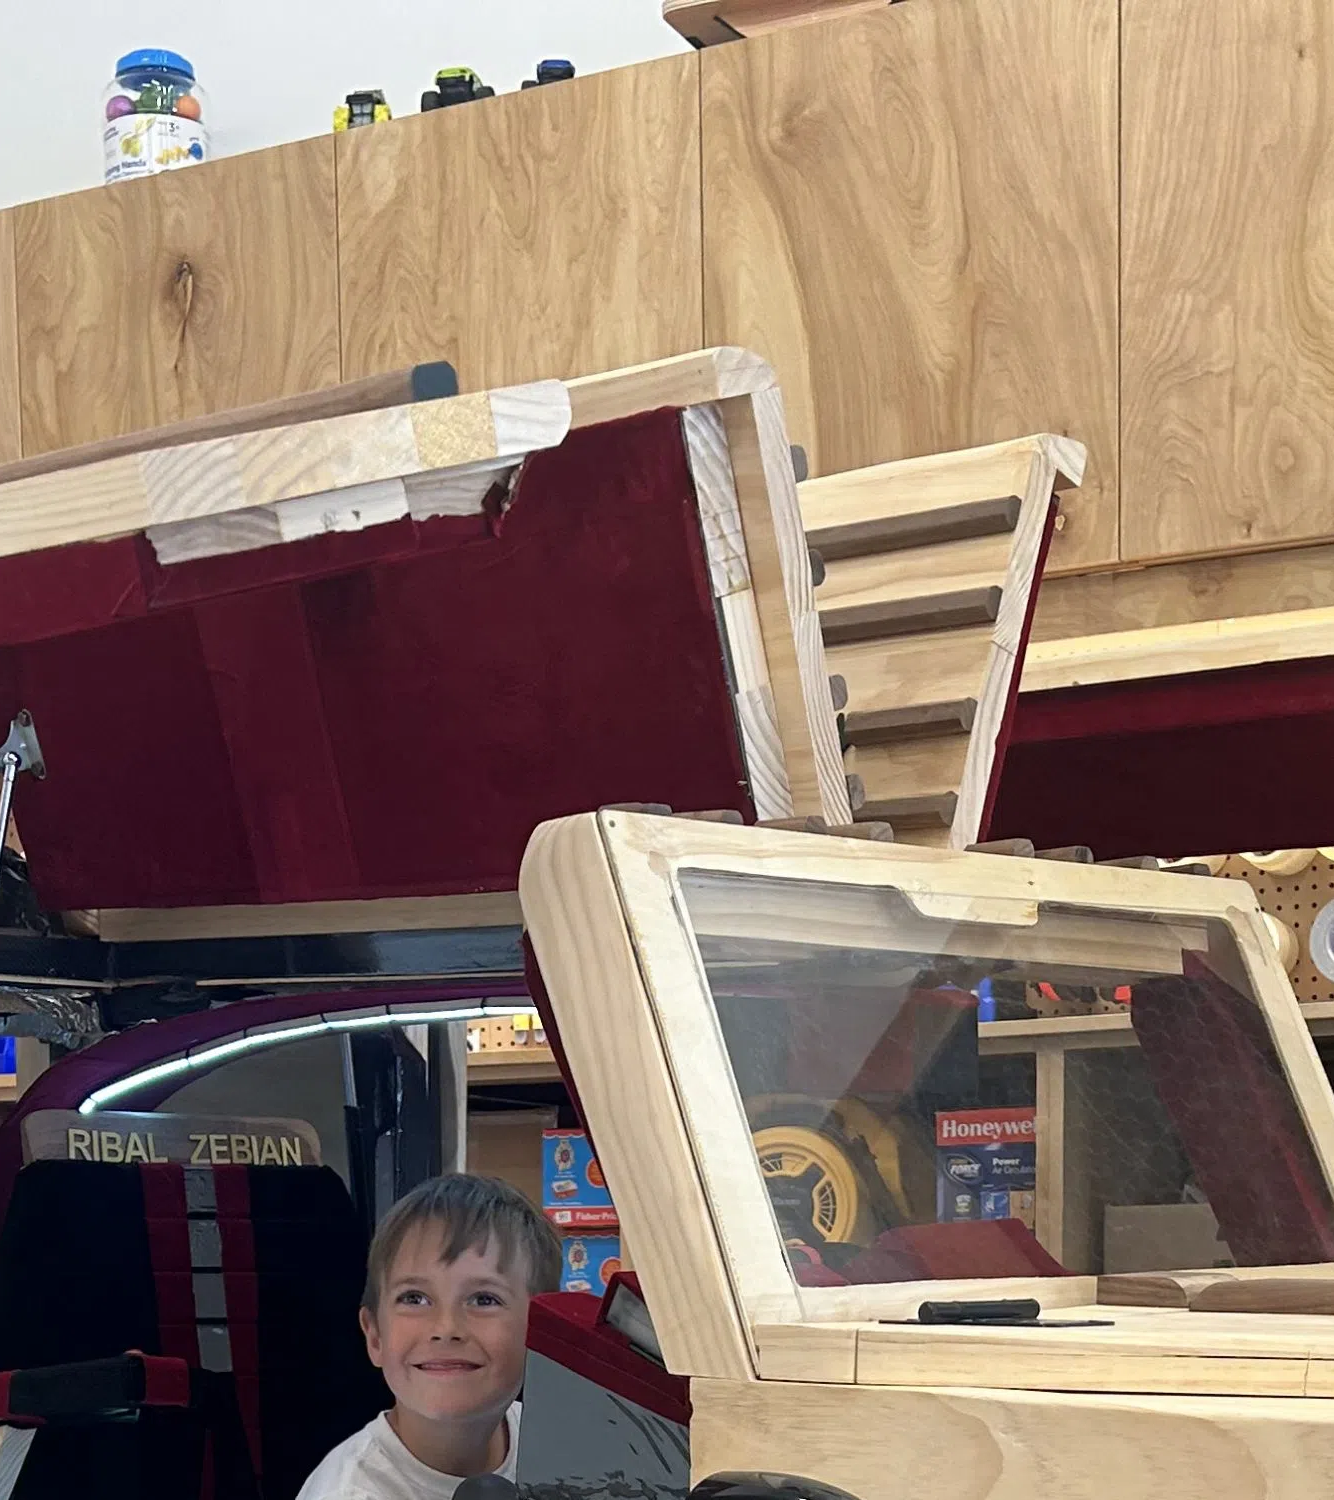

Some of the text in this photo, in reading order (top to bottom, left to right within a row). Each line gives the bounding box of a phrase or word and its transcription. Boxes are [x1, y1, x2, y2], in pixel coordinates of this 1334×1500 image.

[67, 1128, 303, 1166] RIBAL ZEBIAN
[992, 1157, 1020, 1166] Power
